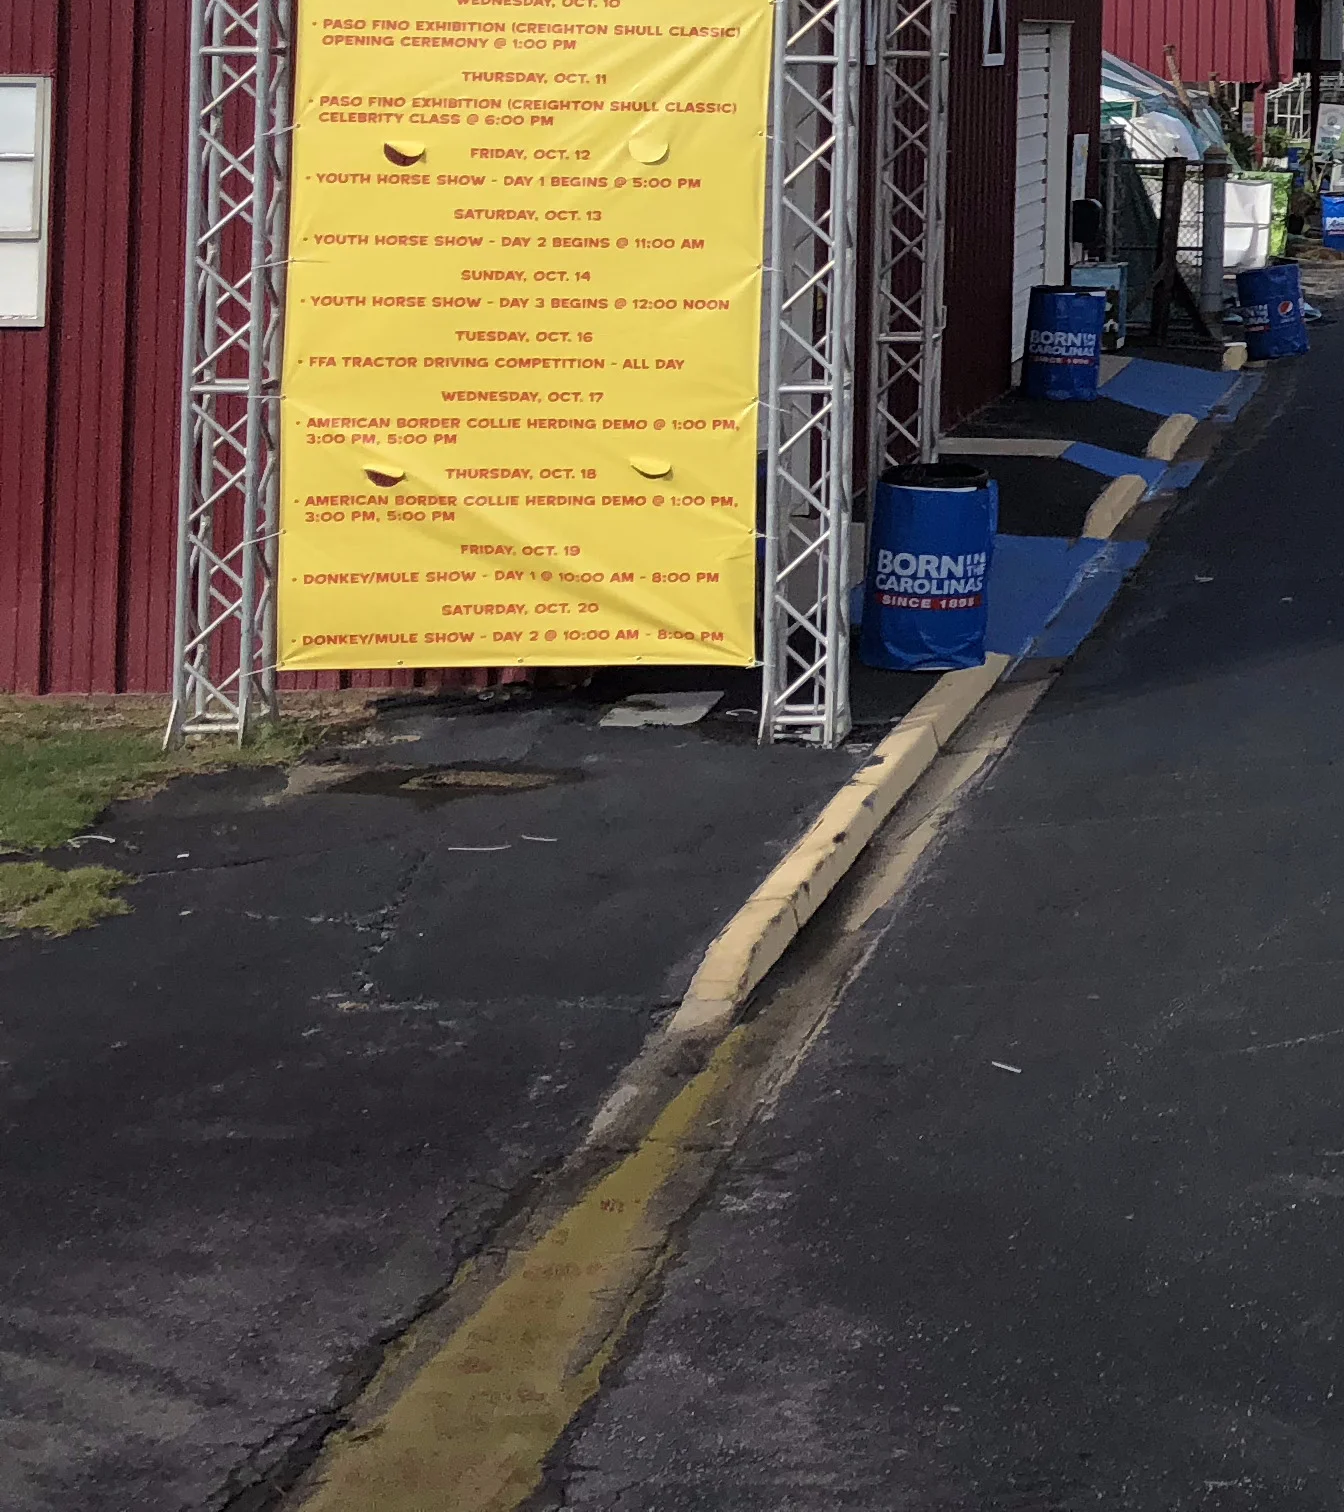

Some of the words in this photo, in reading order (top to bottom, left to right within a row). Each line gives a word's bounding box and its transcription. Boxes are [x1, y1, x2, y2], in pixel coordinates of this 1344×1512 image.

[322, 18, 368, 30] PASO
[371, 19, 412, 32] FINO
[415, 20, 506, 34] EXHIBITION
[511, 22, 610, 35] (CREIGHTON
[614, 24, 662, 37] SHULL
[669, 26, 740, 39] CLASSIC)
[586, 210, 603, 222] 13
[1030, 330, 1081, 346] BORN
[877, 549, 965, 578] BORN
[875, 573, 984, 595] CAROLINAS
[578, 602, 600, 613] 20
[881, 594, 932, 609] SINCE
